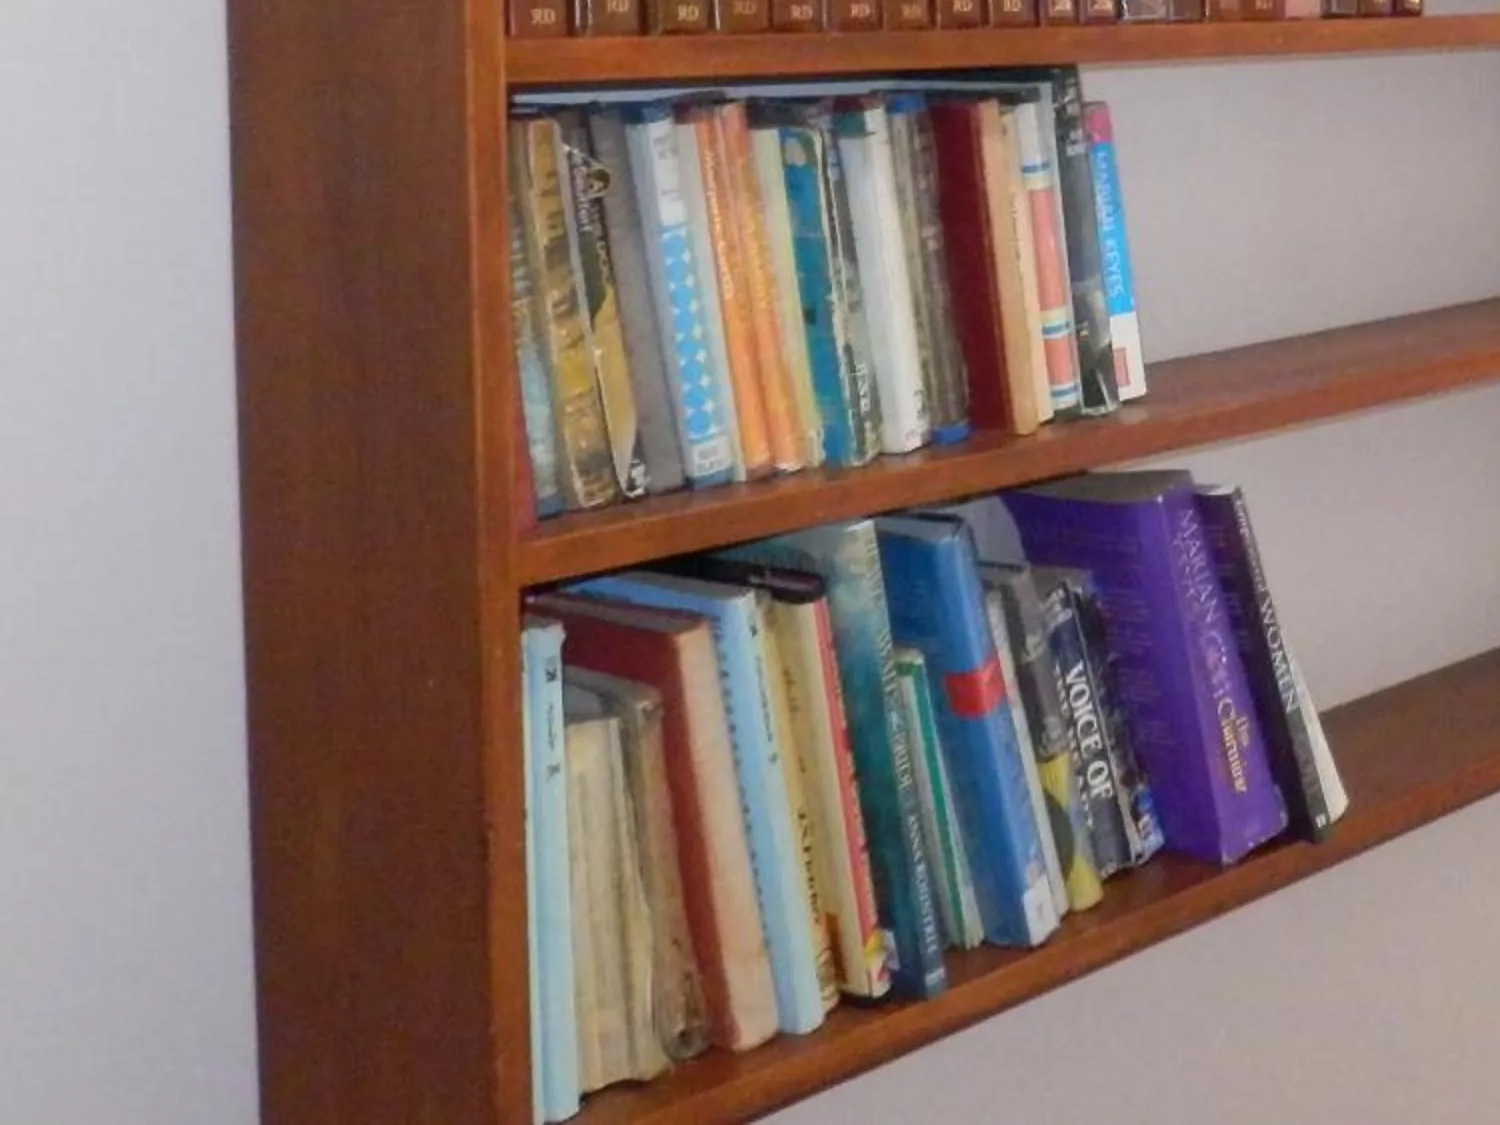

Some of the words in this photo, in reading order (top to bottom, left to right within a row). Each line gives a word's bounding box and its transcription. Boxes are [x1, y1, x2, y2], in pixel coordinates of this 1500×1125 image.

[1103, 239, 1125, 299] KEYES
[1177, 509, 1220, 623] MARIAN
[1261, 596, 1299, 715] WOMEN
[1065, 658, 1104, 759] VOICE
[1086, 760, 1114, 799] OF
